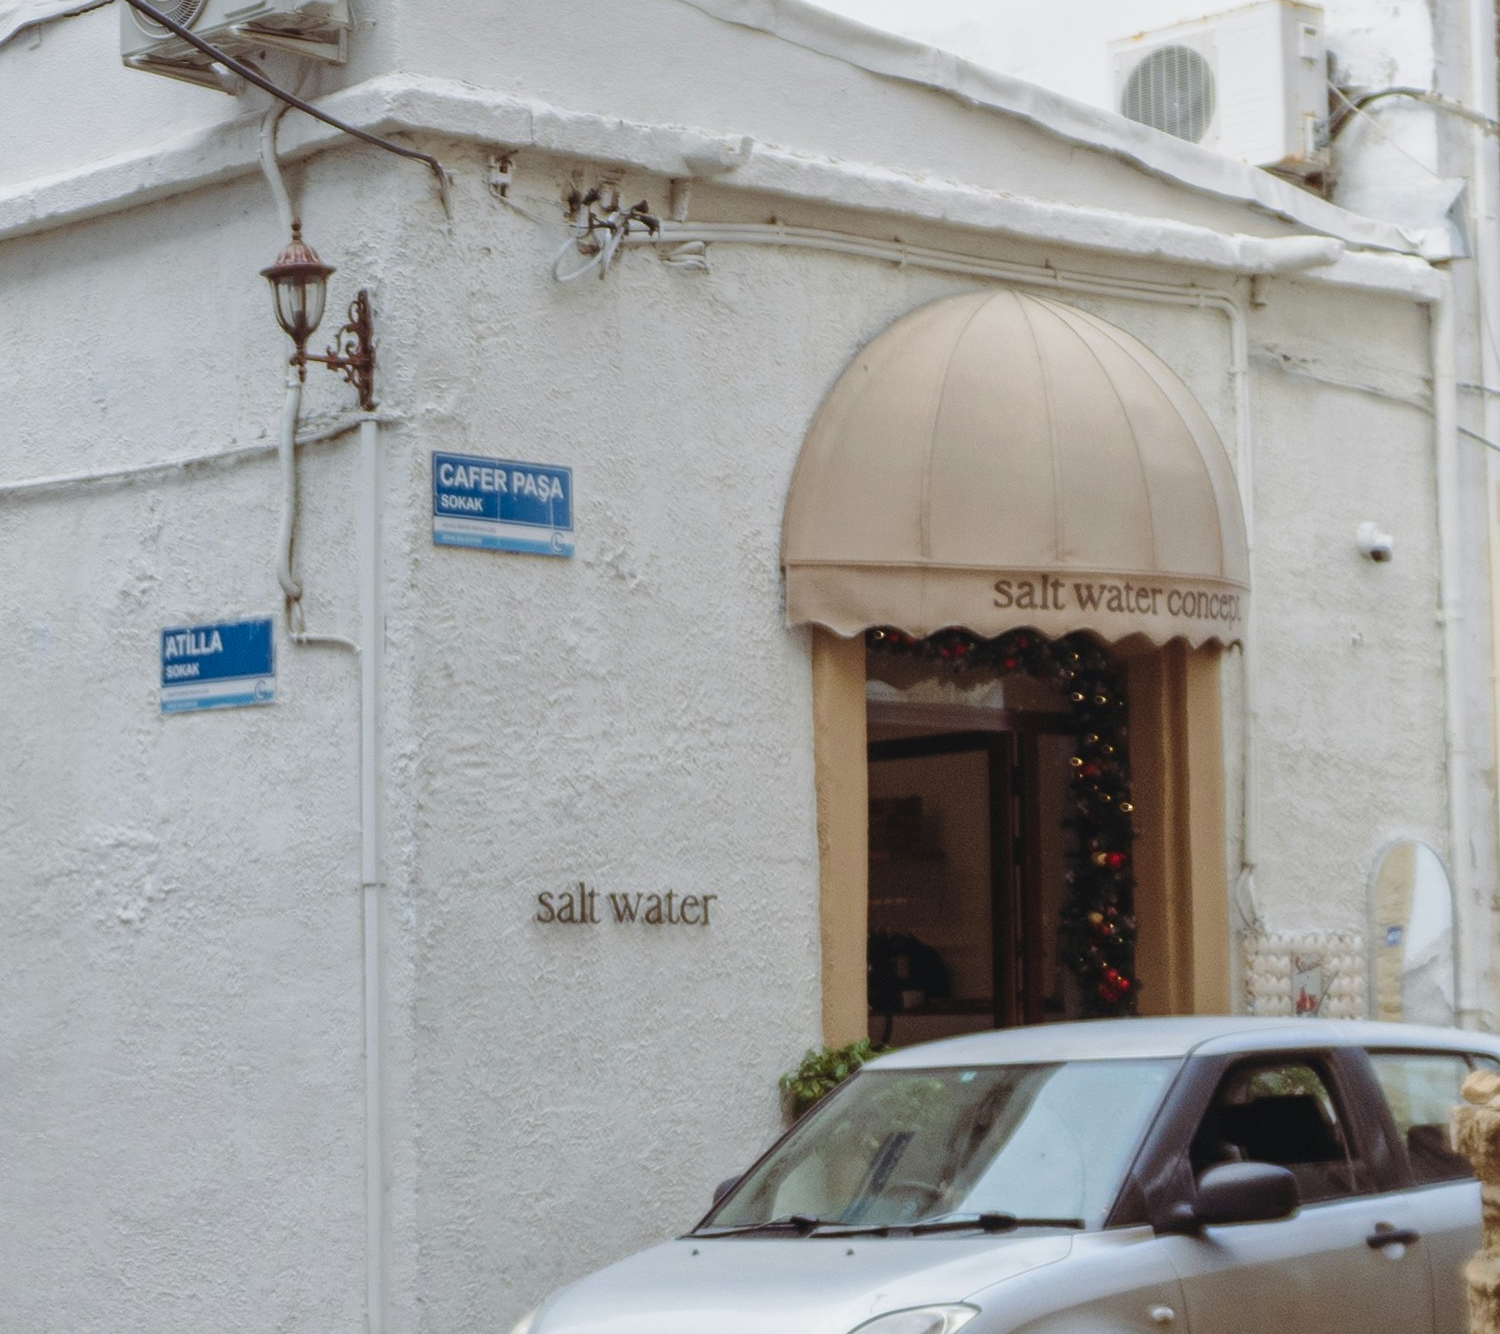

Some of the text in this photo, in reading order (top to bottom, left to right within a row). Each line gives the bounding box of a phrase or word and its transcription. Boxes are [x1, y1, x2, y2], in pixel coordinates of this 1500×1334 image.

[440, 462, 564, 503] CAFER PAŞA
[441, 493, 484, 512] SOKAK
[993, 574, 1066, 611] salt
[1073, 581, 1164, 615] water
[165, 629, 224, 659] ATİLLA
[166, 662, 201, 678] SOKAK
[536, 881, 718, 926] salt water
